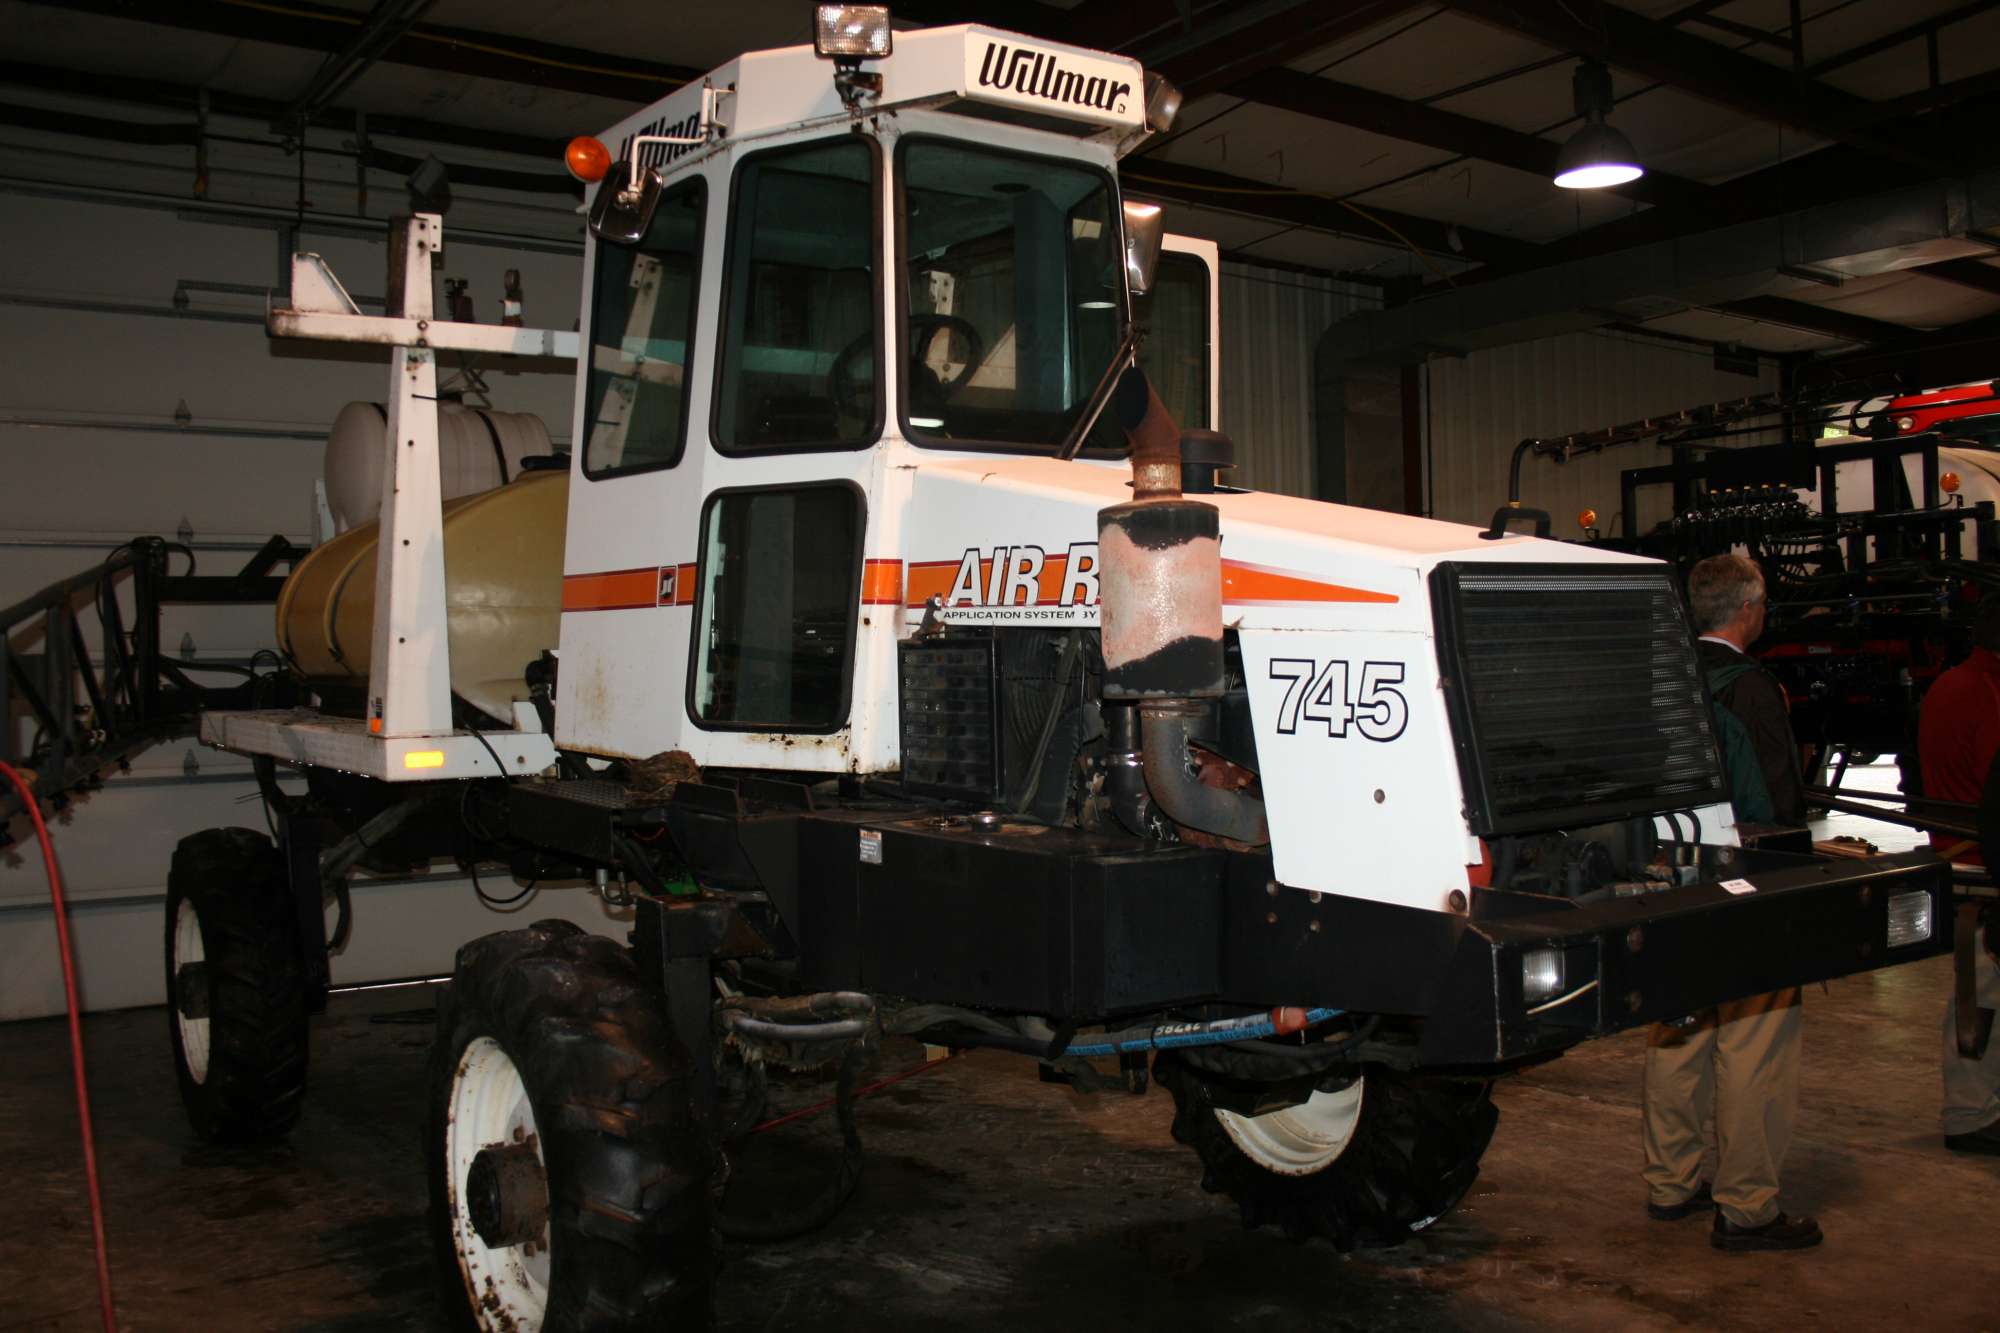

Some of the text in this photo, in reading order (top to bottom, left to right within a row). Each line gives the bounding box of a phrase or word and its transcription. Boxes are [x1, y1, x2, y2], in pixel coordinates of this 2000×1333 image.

[978, 43, 1131, 112] Willmar
[948, 544, 1046, 608] AIR
[943, 610, 1022, 620] APPLICATION
[1023, 610, 1075, 619] SYSTEM
[1269, 658, 1409, 743] 745
